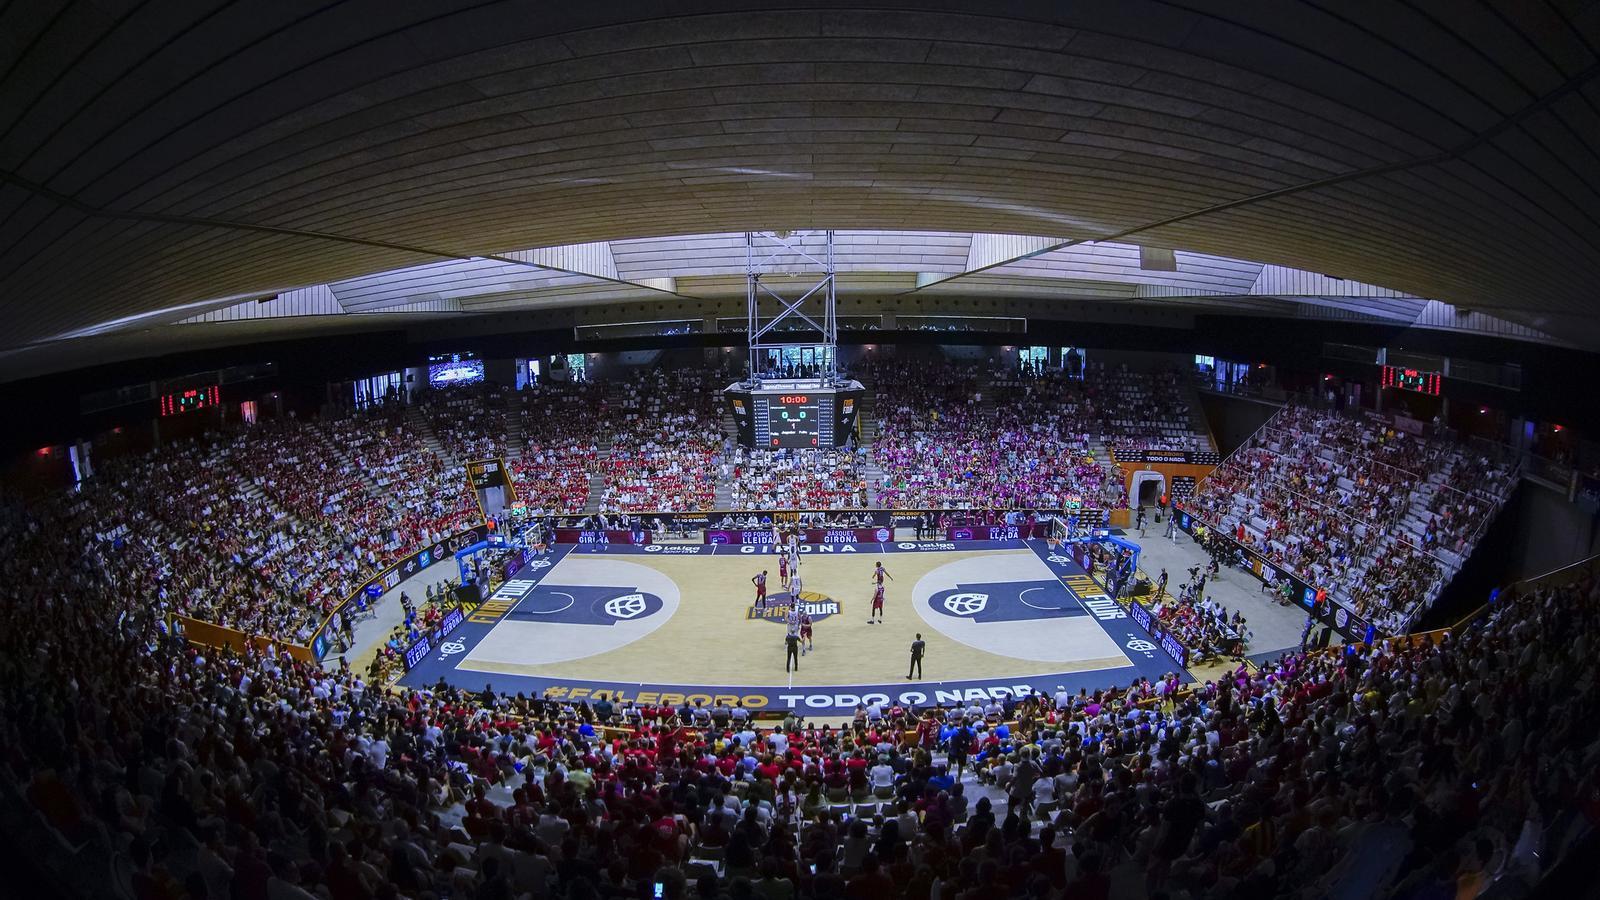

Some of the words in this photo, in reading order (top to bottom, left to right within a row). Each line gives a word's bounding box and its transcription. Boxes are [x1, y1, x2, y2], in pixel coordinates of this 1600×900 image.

[780, 396, 807, 404] 10:00
[781, 411, 788, 419] 0
[799, 411, 806, 419] 0
[742, 536, 774, 544] LLEIDA
[442, 612, 464, 637] GIRONA
[1131, 608, 1150, 632] LLEIDA
[408, 643, 431, 668] LLEIDA
[1161, 638, 1185, 667] GIRONA
[779, 693, 890, 708] TODO
[905, 691, 928, 705] O
